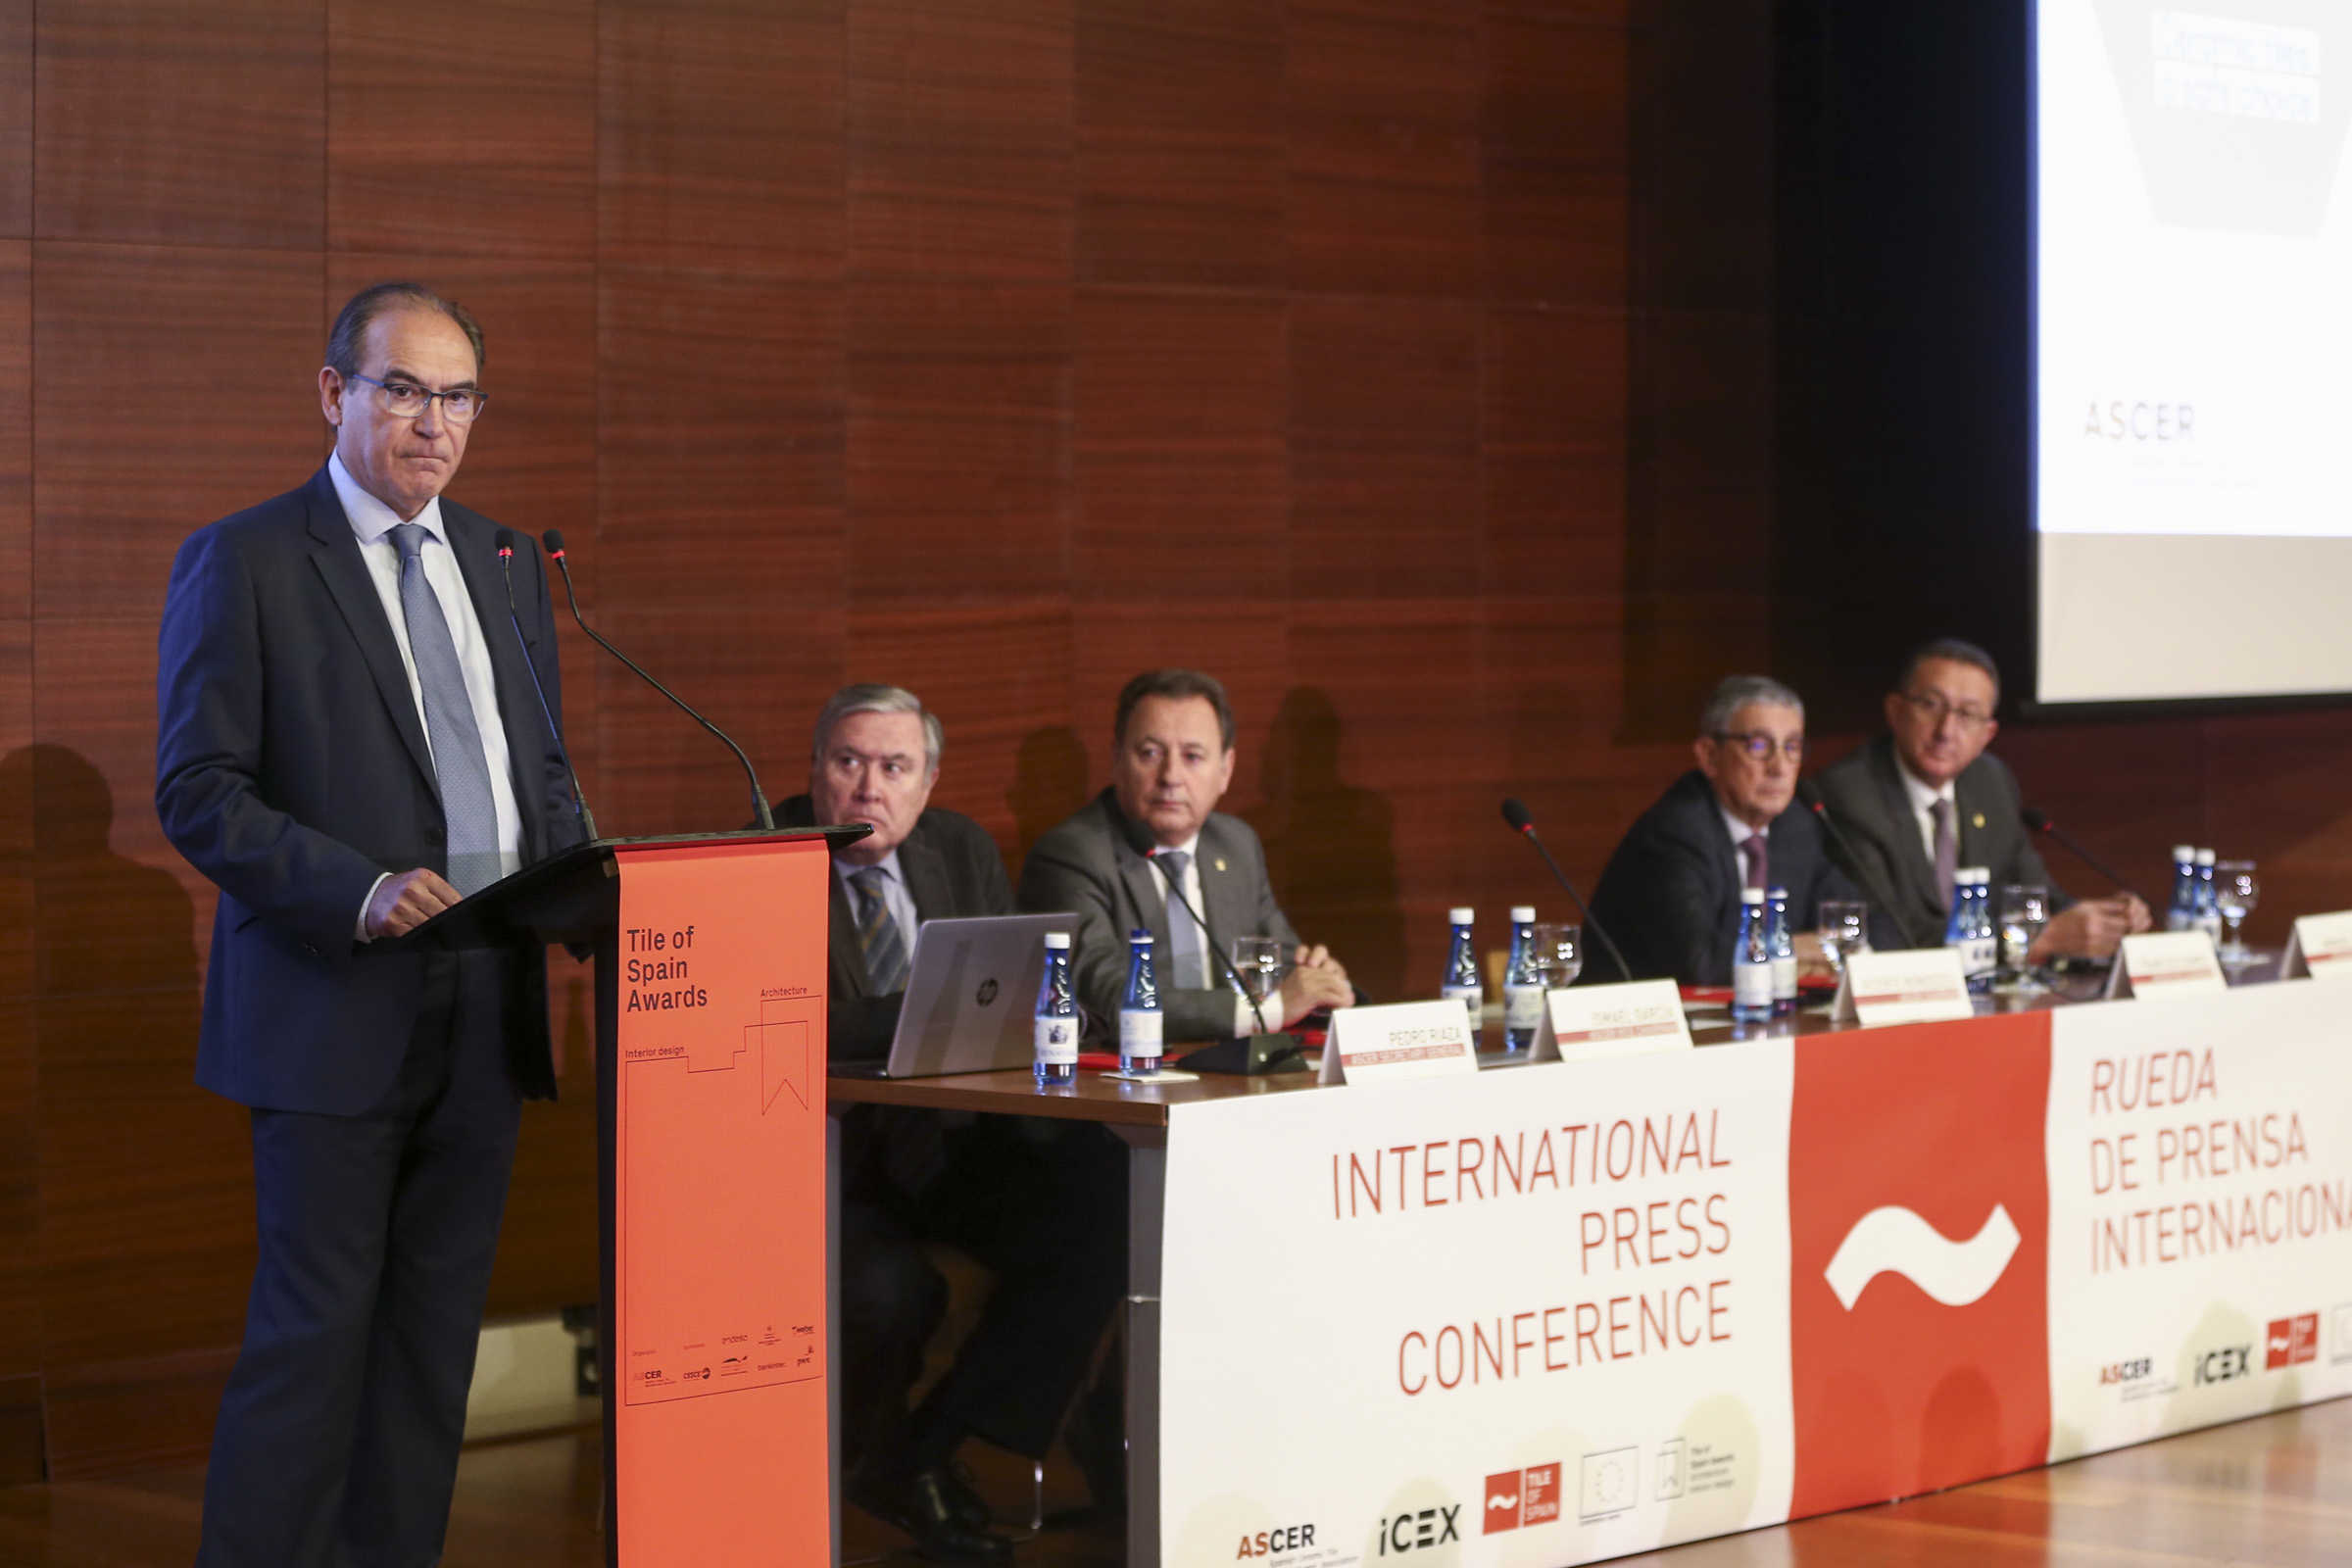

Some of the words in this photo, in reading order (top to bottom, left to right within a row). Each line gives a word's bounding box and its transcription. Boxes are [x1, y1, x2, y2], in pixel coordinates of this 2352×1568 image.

[2083, 400, 2195, 441] ASCER
[626, 928, 665, 952] Tile
[672, 925, 694, 949] of
[626, 956, 688, 986] Spain
[626, 985, 708, 1012] Awards
[760, 986, 808, 998] Architecture
[625, 1048, 657, 1058] Interior
[658, 1045, 684, 1057] design
[2090, 1047, 2217, 1115] RUEDA
[1333, 1108, 1733, 1220] INTERNATIONAL
[2089, 1133, 2140, 1196] DE
[2157, 1111, 2309, 1184] PRENSA
[1580, 1194, 1732, 1274] PRESS
[1398, 1279, 1732, 1396] CONFERENCE
[2099, 1356, 2153, 1385] ASCER
[1527, 1469, 1552, 1487] TILE
[1237, 1523, 1315, 1560] ASCER
